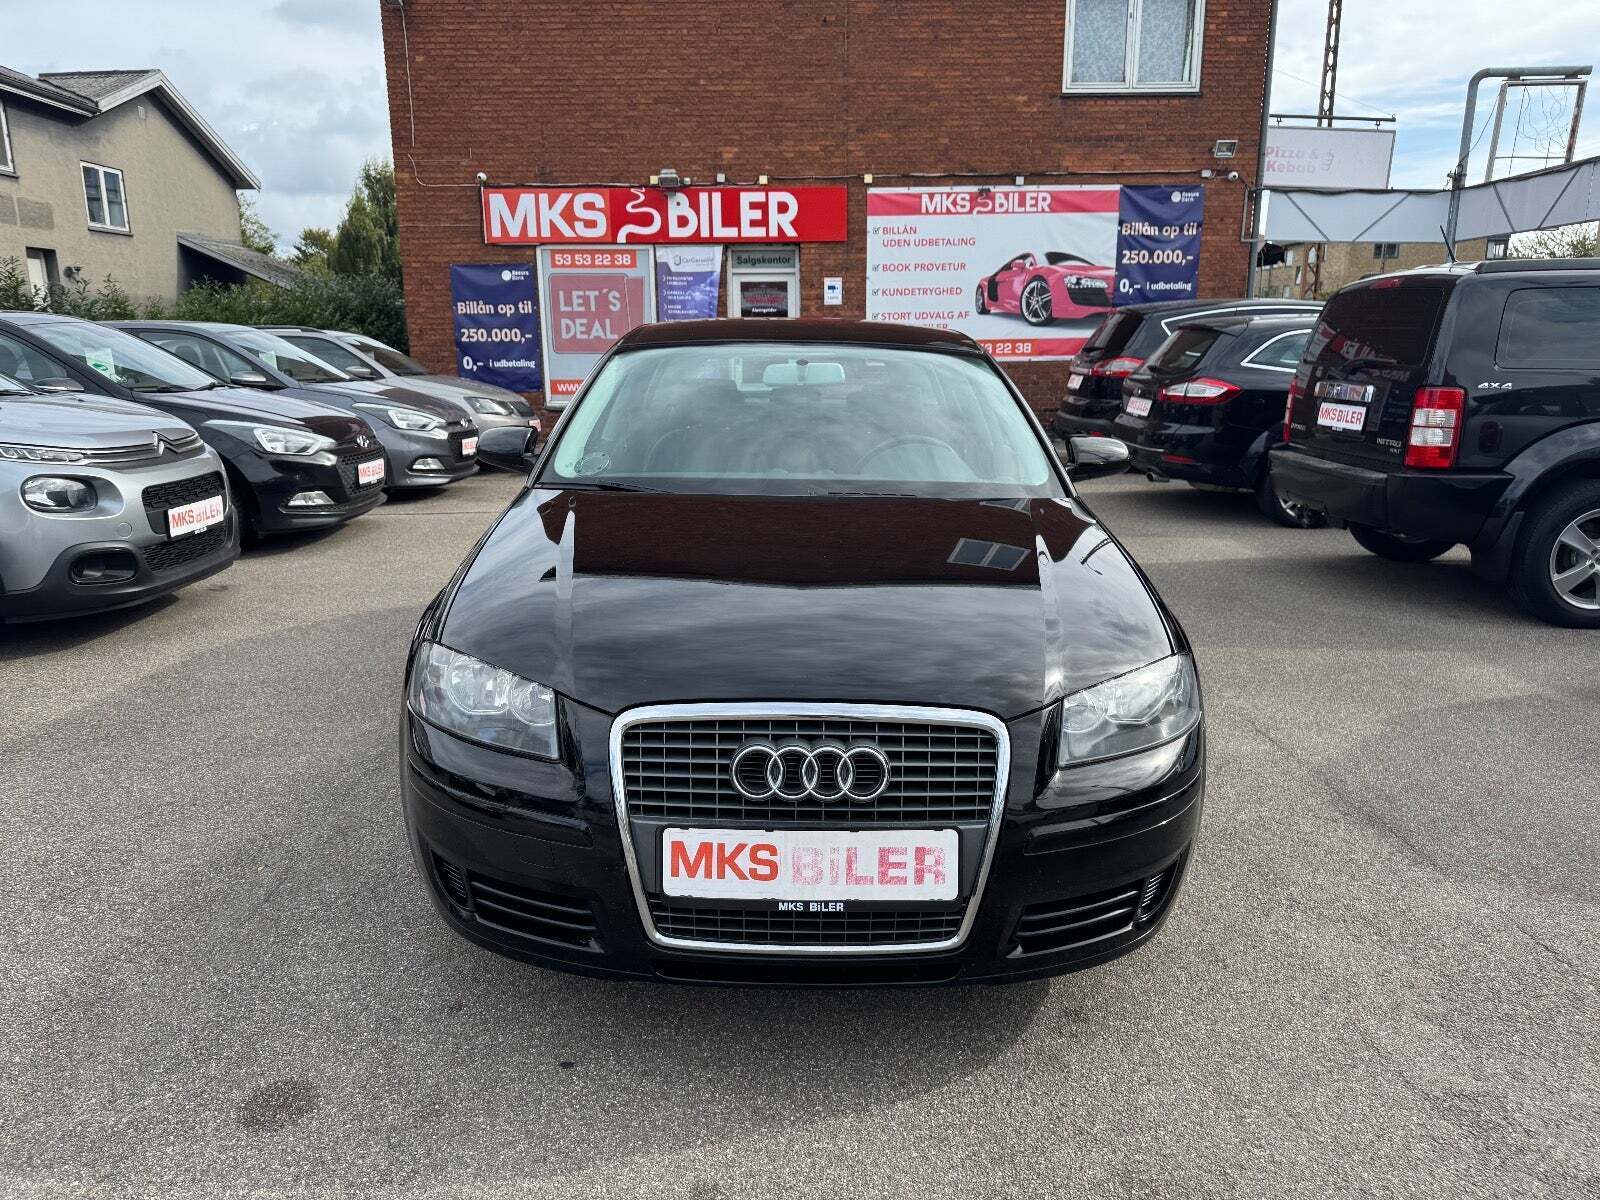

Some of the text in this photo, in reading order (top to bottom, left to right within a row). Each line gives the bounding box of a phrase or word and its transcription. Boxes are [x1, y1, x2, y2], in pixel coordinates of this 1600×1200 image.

[1265, 146, 1319, 159] Pizza &
[1266, 160, 1316, 173] Kebab
[920, 191, 1051, 214] MKS BILER
[488, 191, 799, 238] MKS BILER
[882, 224, 917, 235] BILLÅN
[1121, 222, 1197, 239] Billån op til
[882, 237, 976, 248] UDEN UDBETALING
[555, 253, 631, 265] 53 53 22 38
[736, 255, 791, 266] Salgskontor
[1121, 250, 1194, 266] 250.000,-
[882, 262, 966, 273] BOOK PRØVETUR
[881, 287, 963, 297] KUNDETRYGHED
[1119, 278, 1141, 295] 0,-
[1151, 281, 1192, 291] udbetaling
[457, 300, 532, 317] Billån op til
[881, 311, 970, 321] STORT UDVALG AF
[460, 328, 533, 344] 250.000,-
[560, 318, 619, 340] DEAL
[996, 343, 1011, 354] 22
[1015, 342, 1031, 353] 38
[462, 355, 484, 372] 0,-
[493, 359, 536, 369] udbetaling
[1320, 406, 1337, 421] MKS
[171, 509, 195, 529] MKS
[670, 840, 779, 881] MKS
[778, 901, 804, 911] MKS
